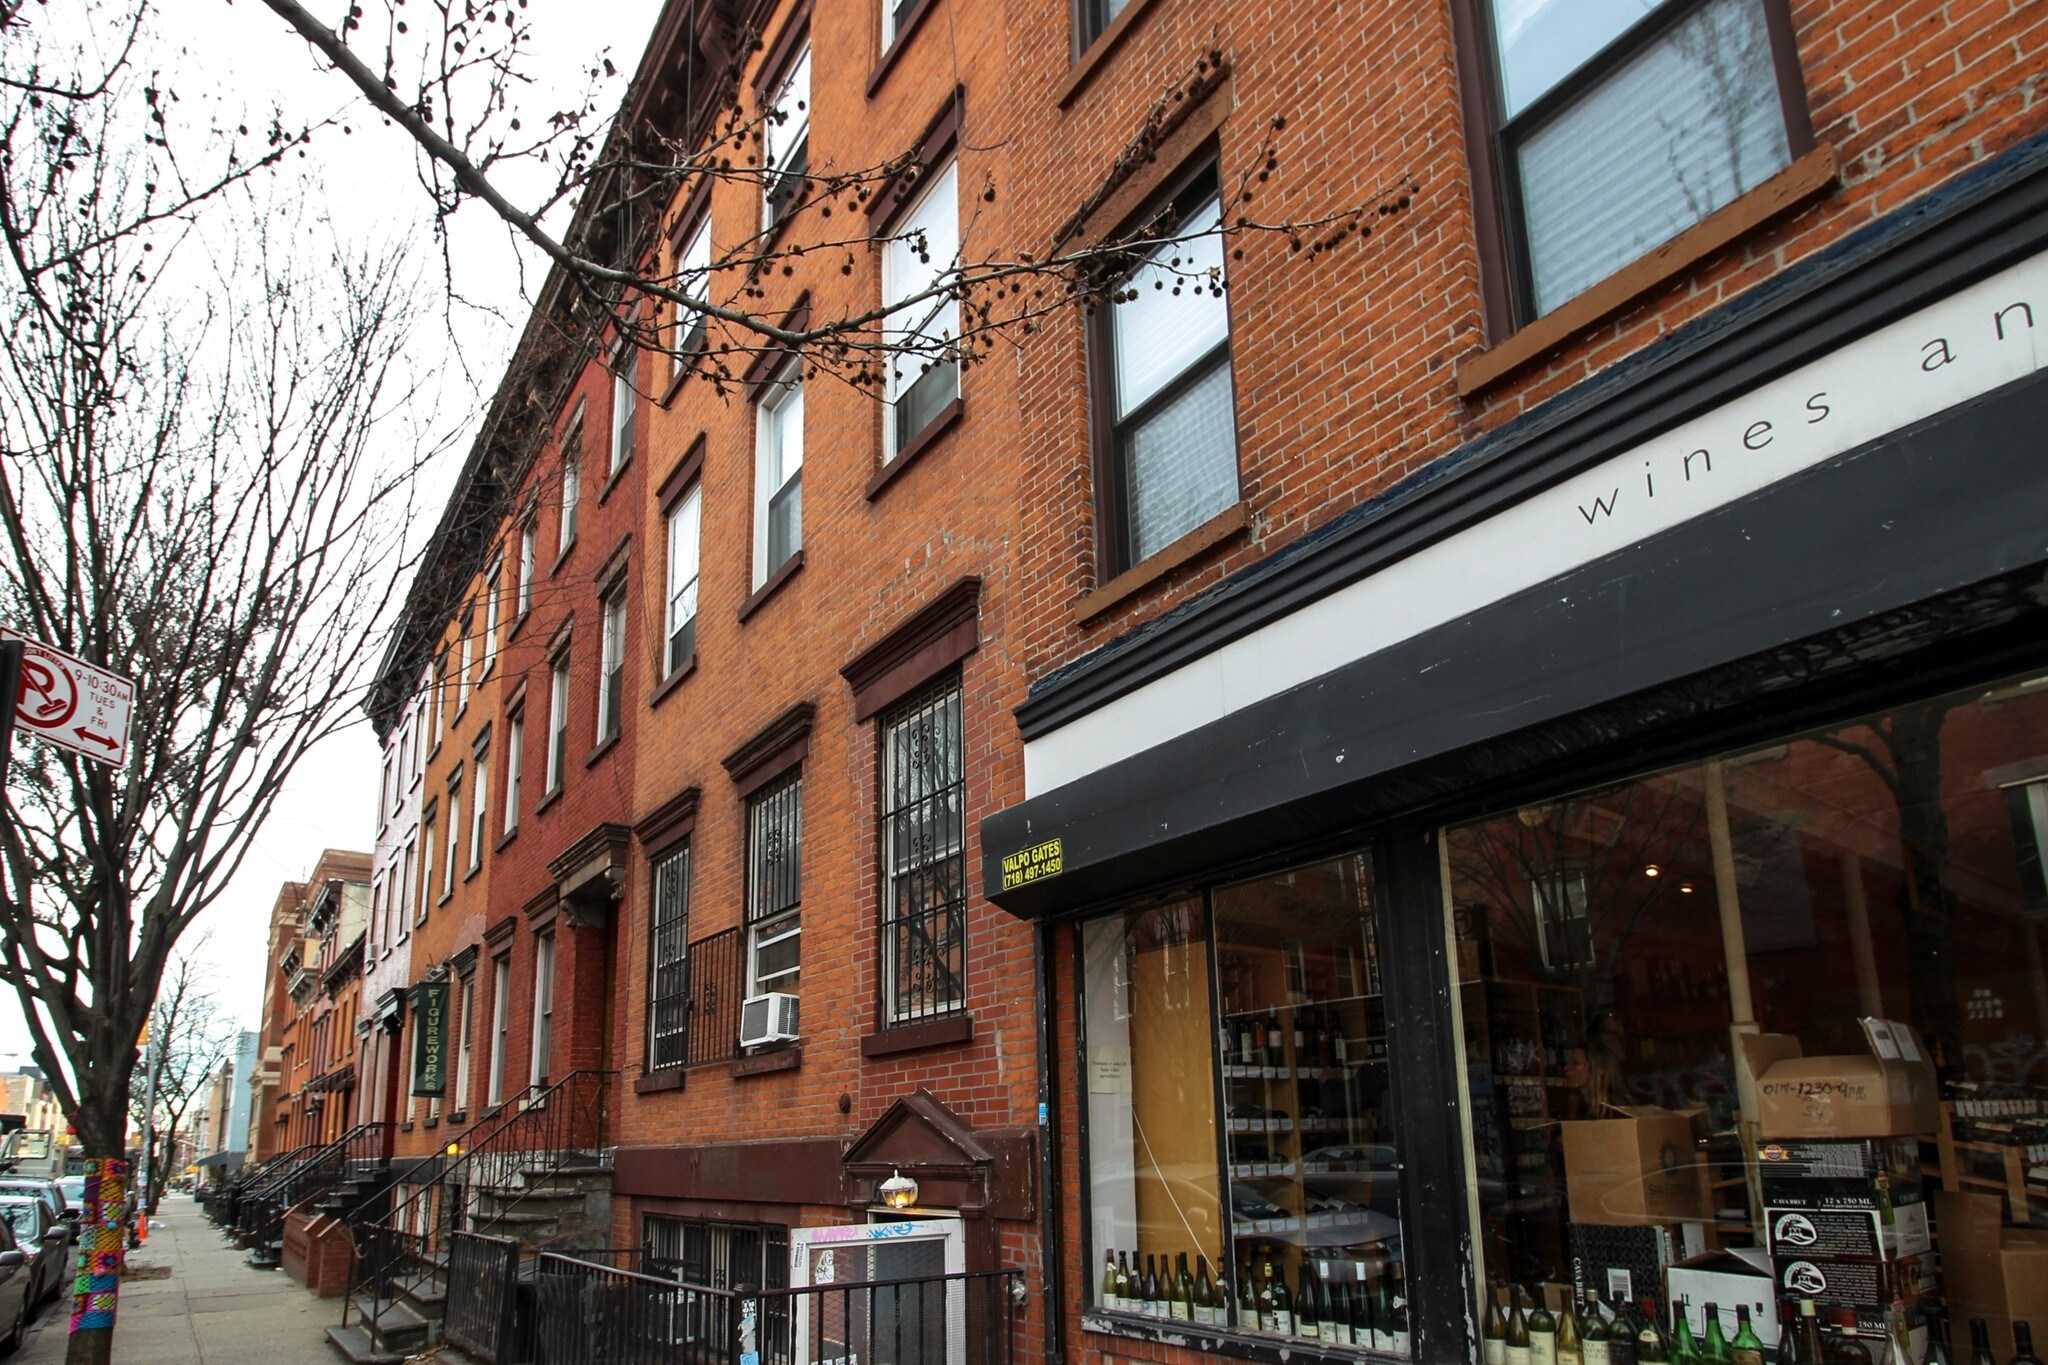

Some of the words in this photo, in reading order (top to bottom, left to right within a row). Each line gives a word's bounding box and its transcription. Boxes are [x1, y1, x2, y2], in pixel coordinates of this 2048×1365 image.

[1577, 391, 1831, 526] wines
[89, 691, 117, 710] TUES
[96, 706, 104, 717] &
[90, 717, 108, 730] FRI
[1003, 852, 1030, 874] VALPO
[1031, 841, 1060, 864] GATES
[1004, 870, 1024, 888] (718)
[1024, 857, 1061, 880] 497-1450
[424, 988, 440, 1091] FIGUREWORKS
[1825, 1197, 1834, 1205] 12
[1842, 1197, 1857, 1205] 750
[1858, 1197, 1873, 1206] ML
